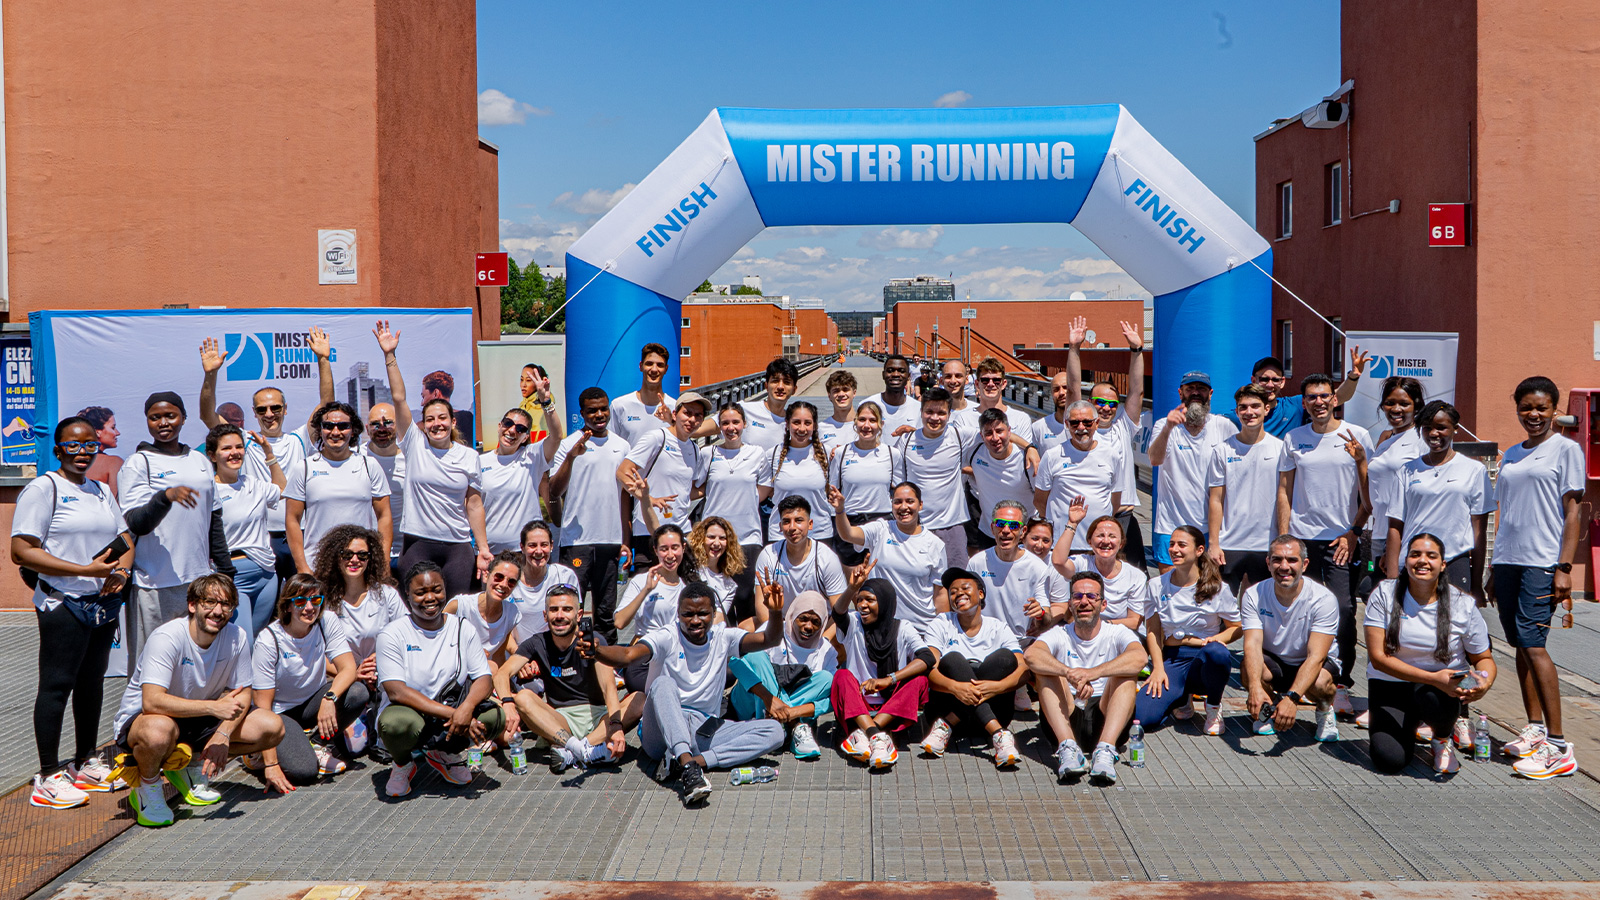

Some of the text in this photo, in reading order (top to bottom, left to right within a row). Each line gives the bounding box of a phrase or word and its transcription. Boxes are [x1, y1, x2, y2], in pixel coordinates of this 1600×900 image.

[766, 142, 1075, 182] MISTER RUNNING
[636, 182, 718, 258] FINISH
[1124, 178, 1206, 254] FINISH
[276, 364, 310, 379] .COM
[1397, 358, 1426, 368] MISTER
[1397, 368, 1433, 377] RUNNING
